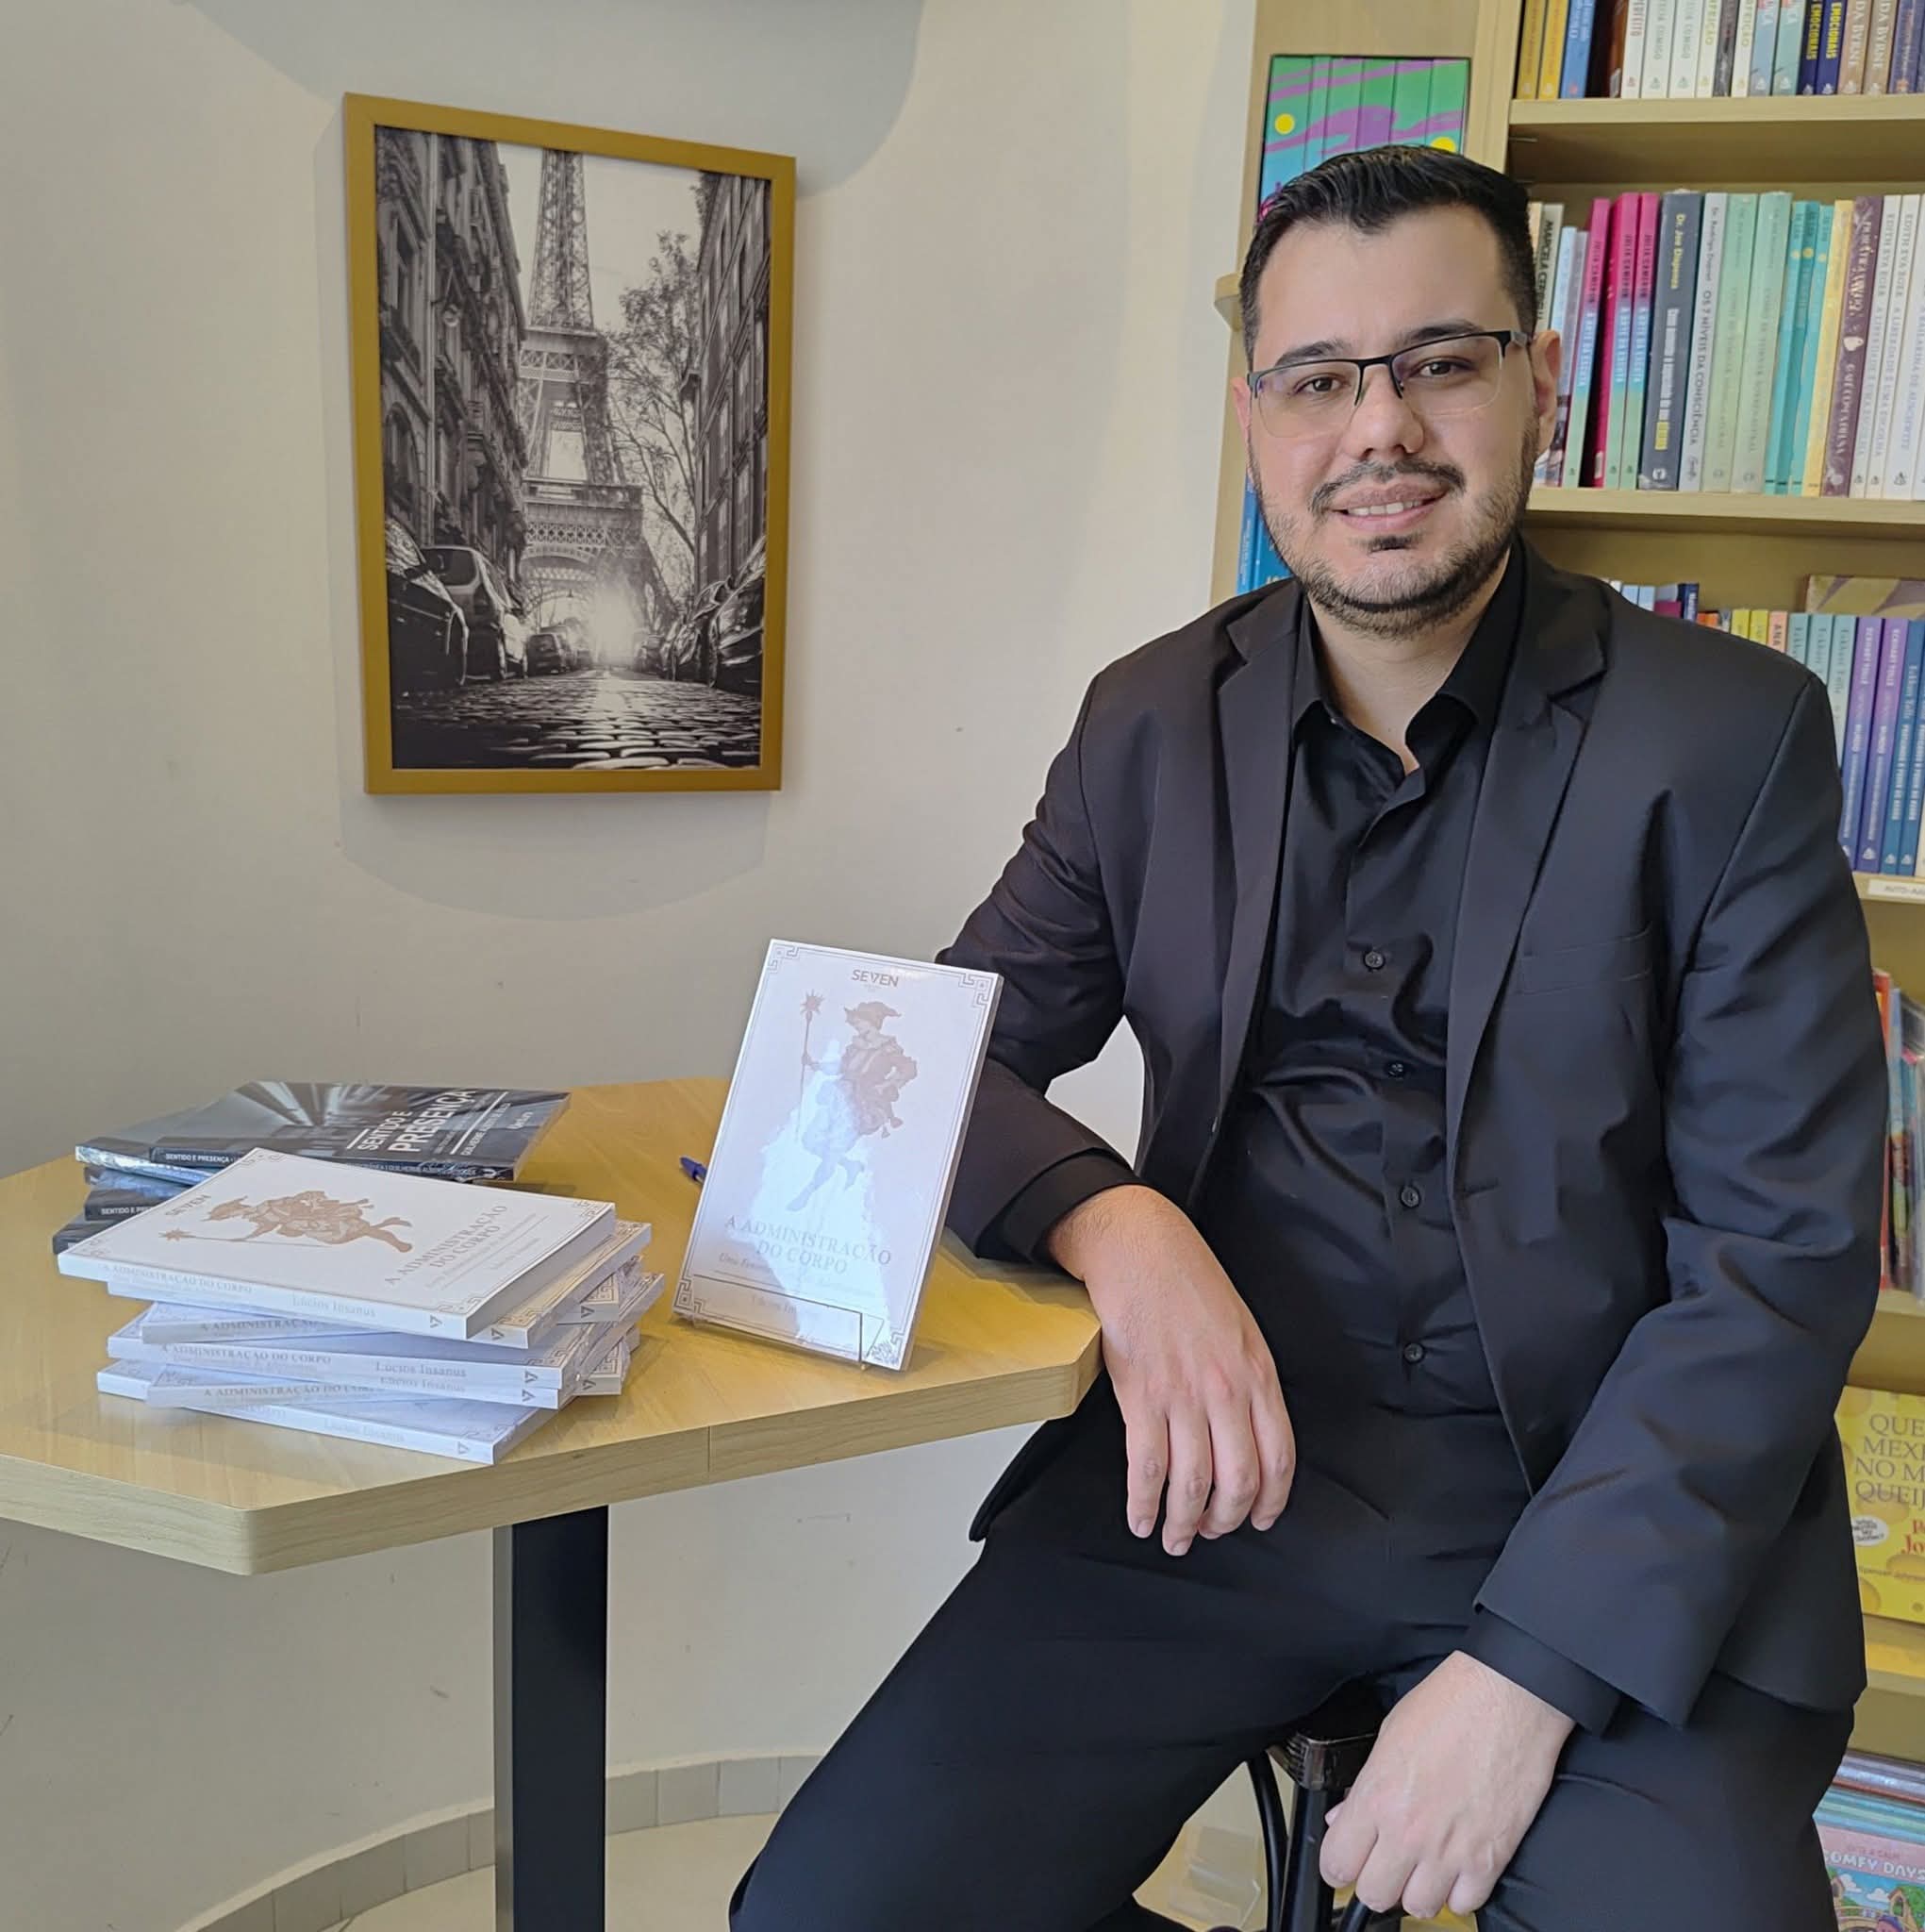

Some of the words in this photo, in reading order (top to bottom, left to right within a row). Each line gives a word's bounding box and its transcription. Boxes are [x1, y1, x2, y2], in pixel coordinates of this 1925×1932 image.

[1806, 3, 1823, 60] EMOCIONAIS
[1826, 2, 1842, 59] EMOCIONAIS
[1849, 25, 1865, 68] BYRNE
[1872, 26, 1889, 69] BYRNE
[1701, 289, 1713, 307] OS
[1695, 355, 1707, 371] DA
[1688, 372, 1705, 446] CONSCIÊNCIA
[852, 969, 899, 988] SEVEN
[357, 1115, 400, 1150] SENTIDO
[387, 1090, 477, 1153] PRESENÇA
[165, 1153, 192, 1161] SENTIDO
[197, 1154, 229, 1163] PRESENÇA
[101, 1207, 129, 1216] SENTIDO
[165, 1194, 212, 1216] SEVEN
[385, 1277, 401, 1286] A
[398, 1205, 508, 1274] ADMINISTRAÇÃO
[429, 1254, 456, 1268] DO
[453, 1224, 500, 1254] CORPO
[725, 1216, 737, 1228] A
[739, 1220, 892, 1266] ADMINISTRAÇÃO
[756, 1240, 783, 1257] DO
[787, 1247, 848, 1274] CORPO
[332, 1301, 376, 1318] Insanus
[172, 1346, 269, 1360] ADMINISTRAÇÃO
[272, 1352, 288, 1360] DO
[290, 1355, 332, 1365] CORPO
[421, 1363, 467, 1377] Insanus
[204, 1389, 211, 1397] A
[216, 1385, 321, 1397] ADMINISTRAÇÃO
[1869, 1413, 1925, 1438] QUE
[1864, 1435, 1925, 1461] MEX
[1855, 1457, 1896, 1479] NO
[1855, 1480, 1925, 1510] QUEIJ
